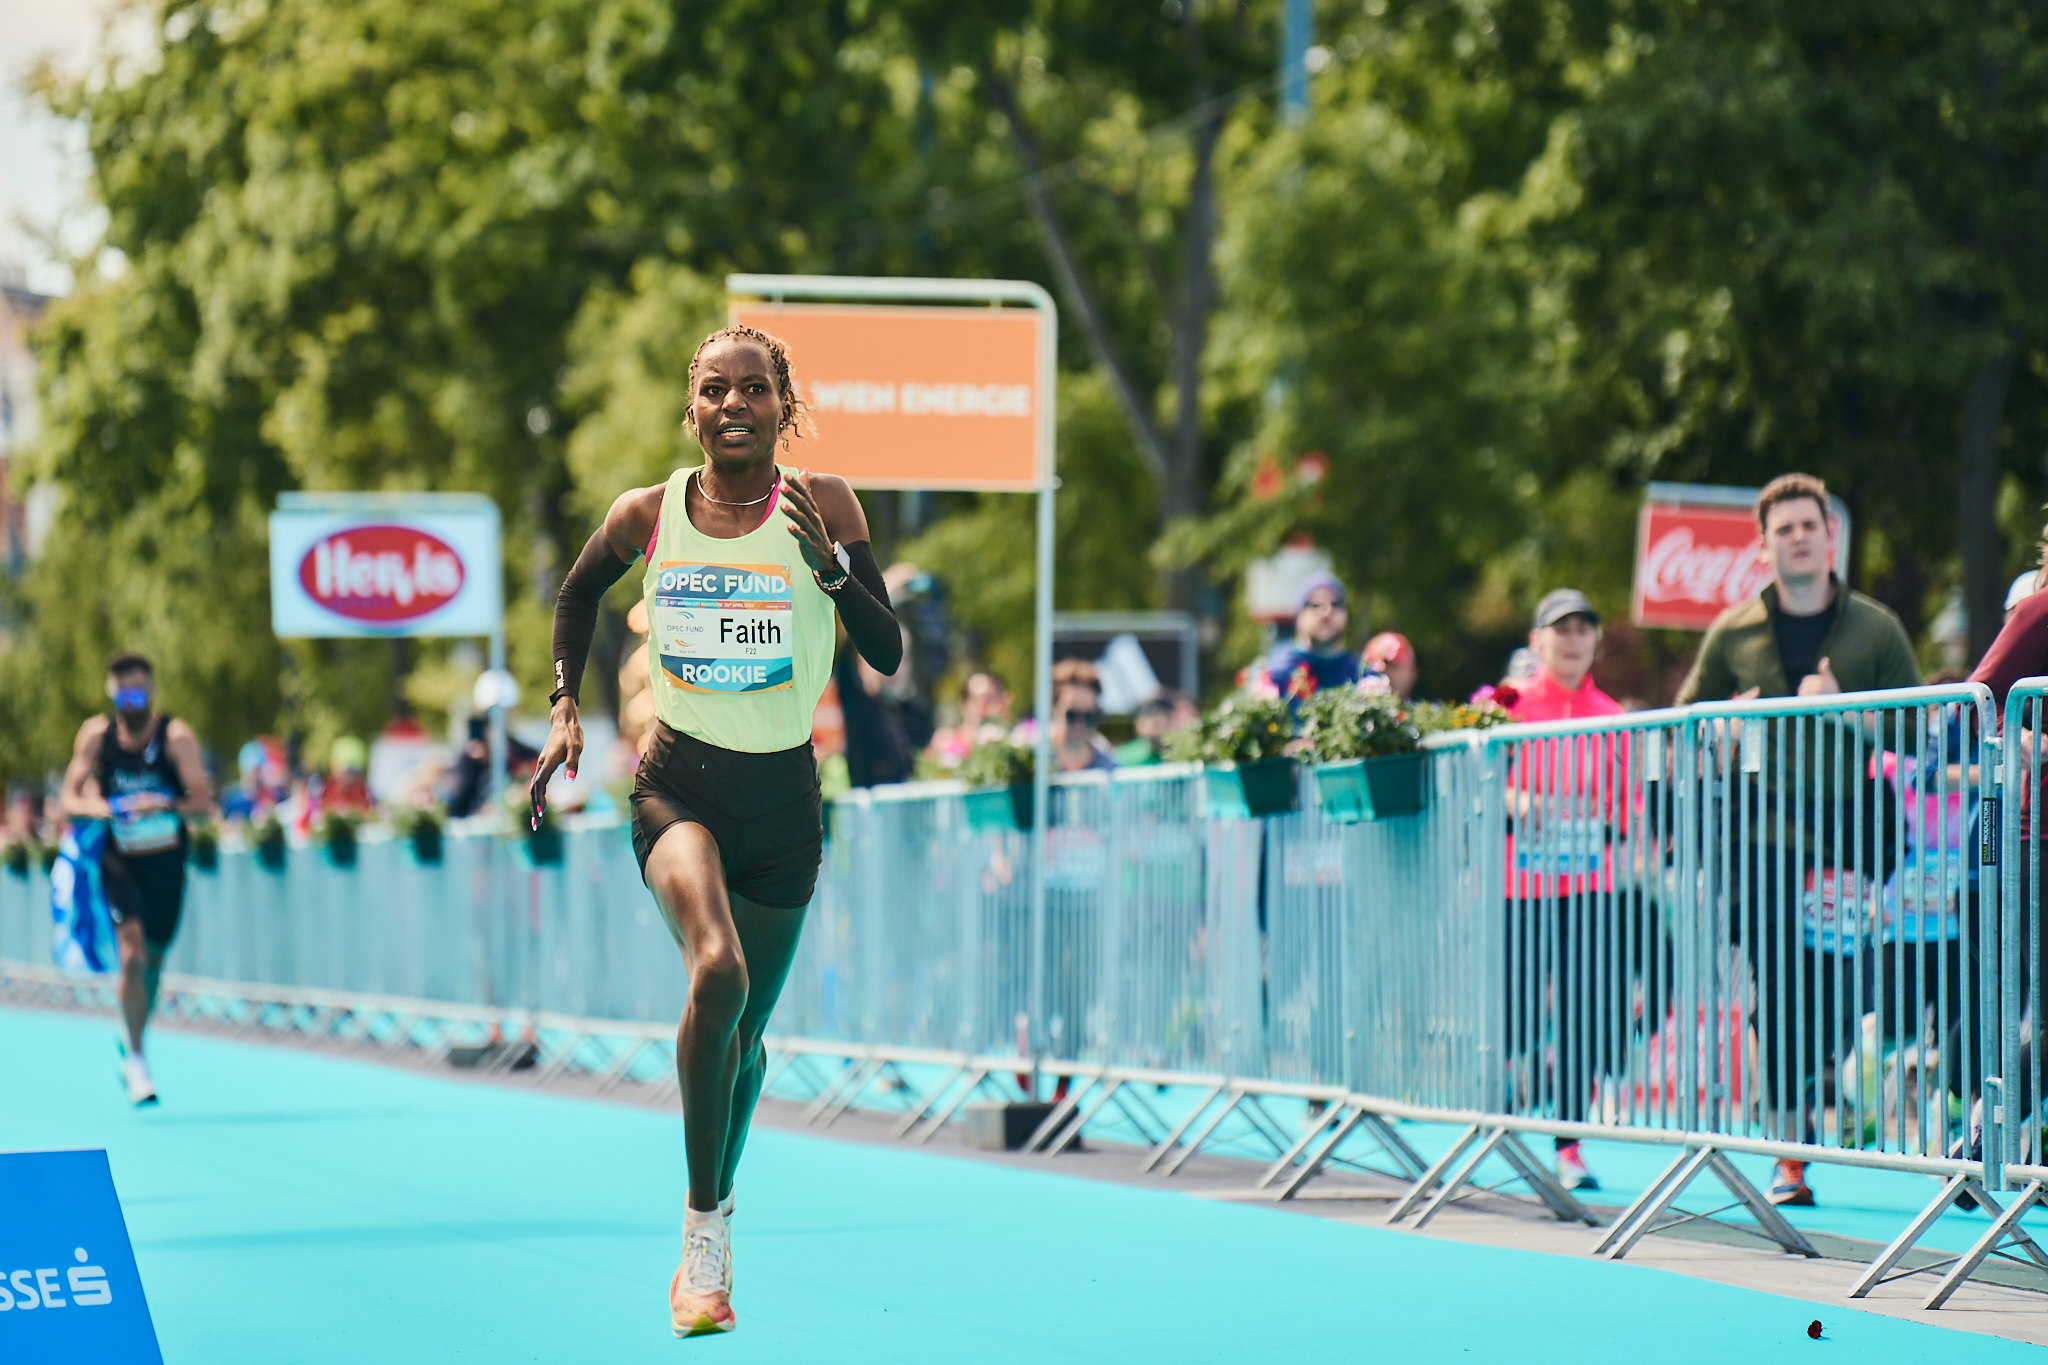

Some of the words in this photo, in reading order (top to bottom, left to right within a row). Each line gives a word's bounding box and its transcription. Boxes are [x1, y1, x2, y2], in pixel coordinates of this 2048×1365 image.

[810, 380, 896, 413] WIEN
[901, 381, 1032, 417] ENERGIE
[661, 572, 717, 593] OPEC
[724, 574, 786, 594] FUND
[720, 618, 781, 644] Faith
[682, 663, 767, 684] ROOKIE
